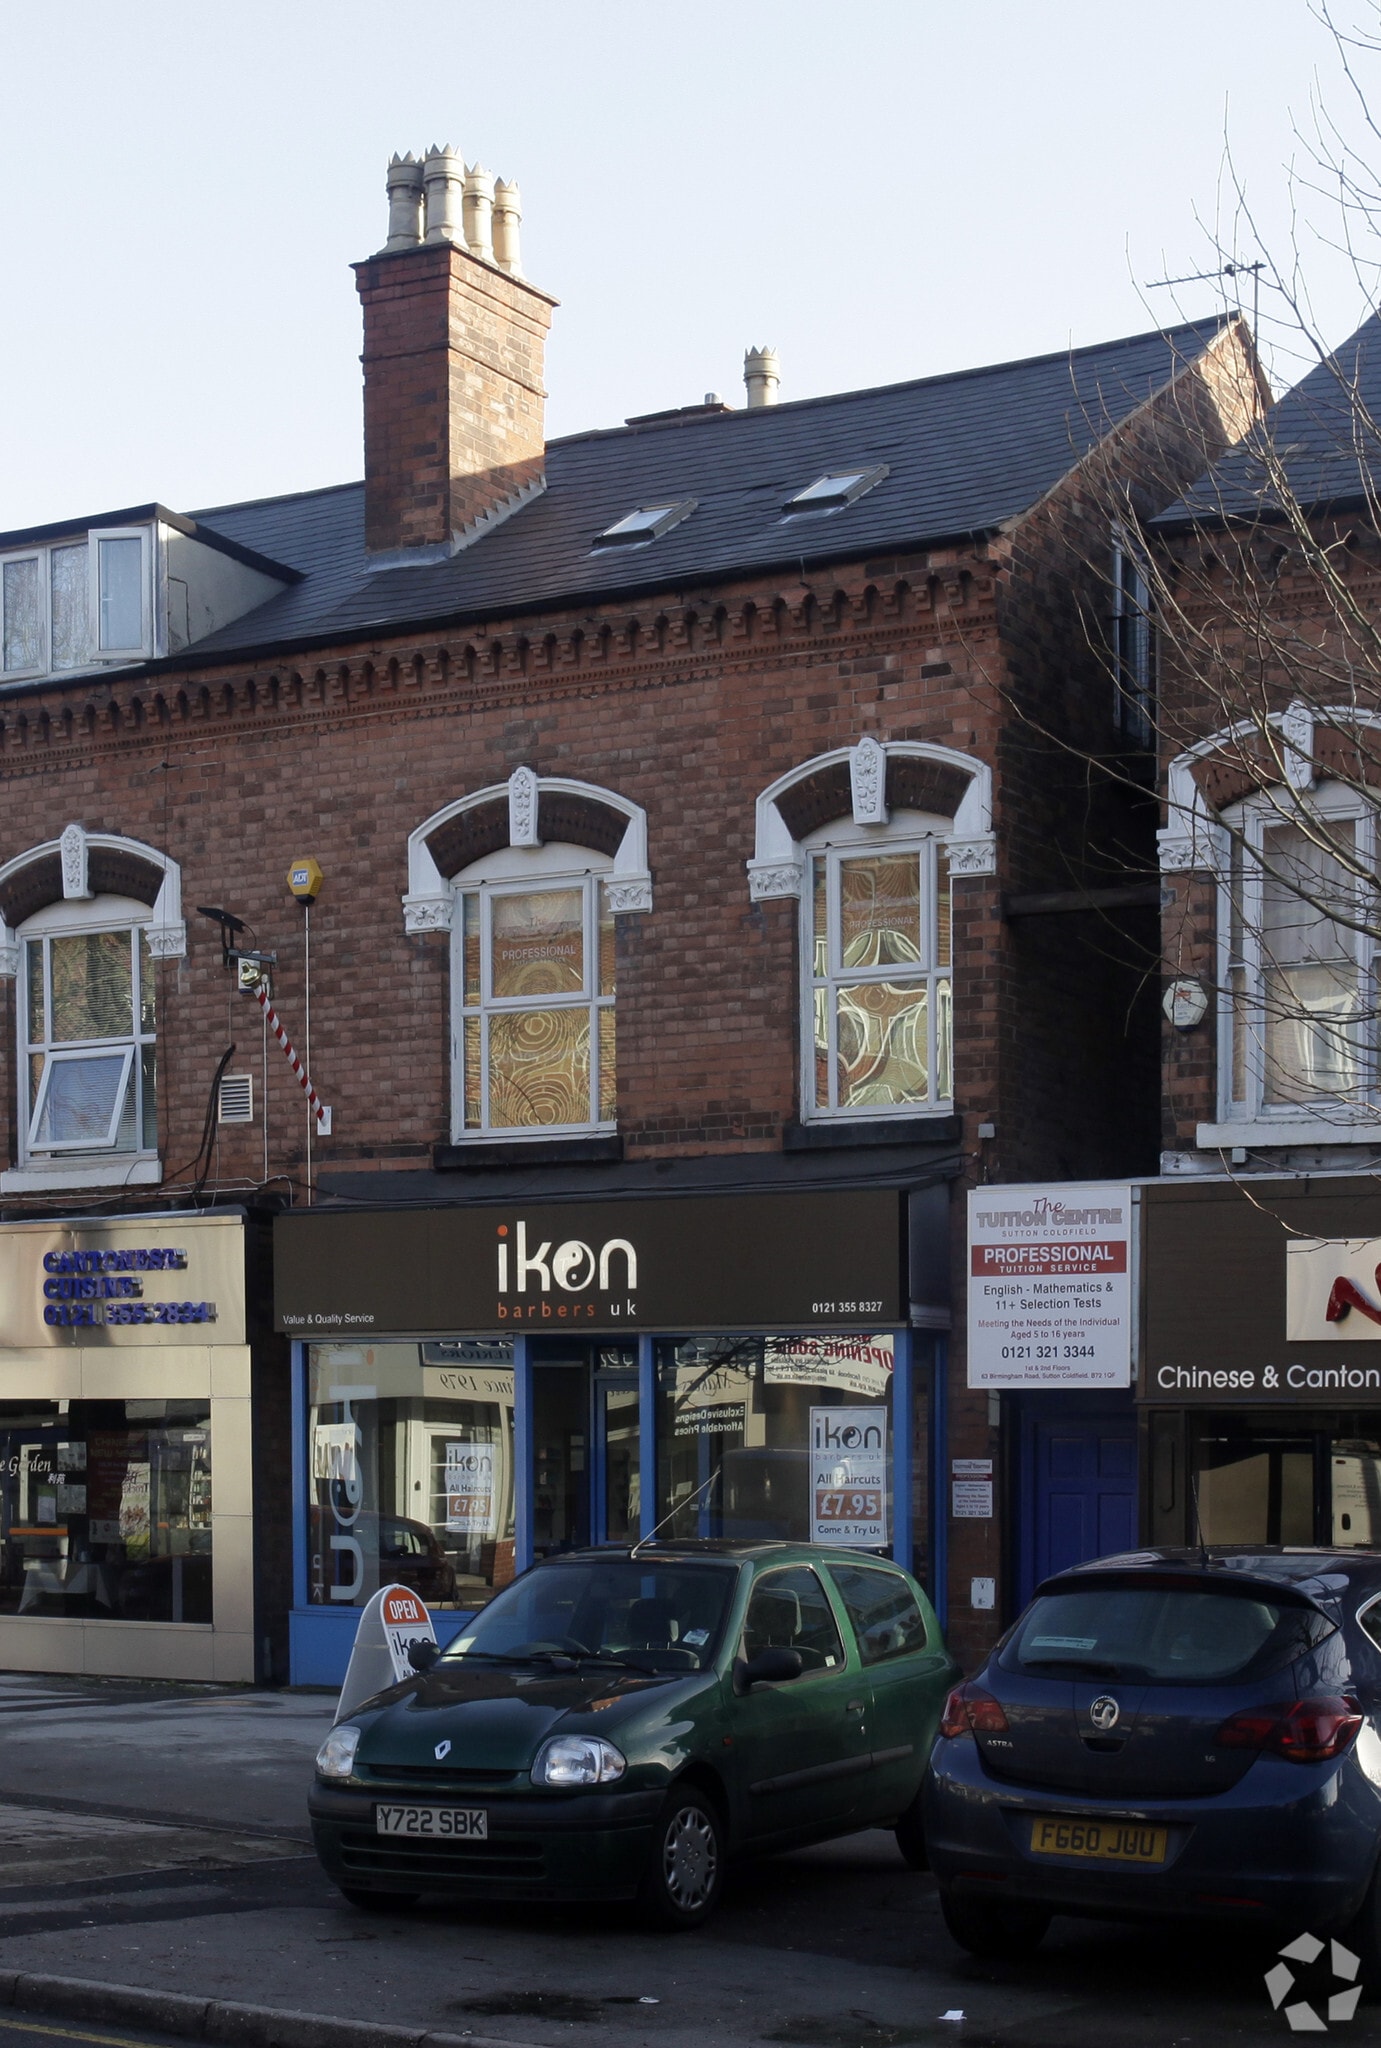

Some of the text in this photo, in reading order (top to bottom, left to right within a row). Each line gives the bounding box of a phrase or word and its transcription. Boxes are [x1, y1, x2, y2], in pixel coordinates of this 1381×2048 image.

[293, 872, 308, 883] ADT
[849, 916, 915, 930] PROFESSIONAL
[502, 945, 576, 960] PROFESSIONAL
[1032, 1197, 1066, 1214] The
[976, 1208, 1122, 1228] TUITION CENTRE
[1002, 1228, 1097, 1238] SUTTON COLDFIELD
[43, 1248, 187, 1273] CANTONESE
[497, 1220, 637, 1293] ikon
[984, 1245, 1115, 1264] PROFESSIONAL
[999, 1263, 1097, 1273] TUITION SERVICE
[43, 1276, 143, 1299] CUISINE
[983, 1285, 1023, 1297] English
[1033, 1282, 1102, 1294] Mathematics
[1105, 1281, 1113, 1292] &
[498, 1298, 637, 1319] barbers uk
[812, 1301, 883, 1313] 0121 355 8327
[995, 1297, 1102, 1310] 11+ Selection Tests
[43, 1301, 215, 1325] 0121 355 2834
[283, 1312, 375, 1326] Value & Quality Service
[978, 1317, 1120, 1329] Meeting the Needs of the Individual
[1010, 1331, 1031, 1340] Aged
[1051, 1330, 1061, 1338] 16
[1063, 1331, 1086, 1340] years
[1001, 1345, 1095, 1359] 0121 321 3344
[1157, 1365, 1255, 1389] Chinese
[1261, 1365, 1279, 1388] &
[815, 1417, 881, 1449] ikon
[448, 1449, 492, 1473] ikon
[815, 1452, 881, 1461] barbers uk
[817, 1473, 881, 1485] All Haircuts
[450, 1484, 460, 1493] All
[454, 1499, 486, 1514] £7.95
[820, 1494, 878, 1516] £7.95
[818, 1525, 881, 1536] Come & Try Us
[388, 1600, 419, 1620] OPEN
[986, 1739, 1014, 1748] ASTRA
[380, 1807, 484, 1835] Y722 SBK
[1040, 1823, 1100, 1851] FG60
